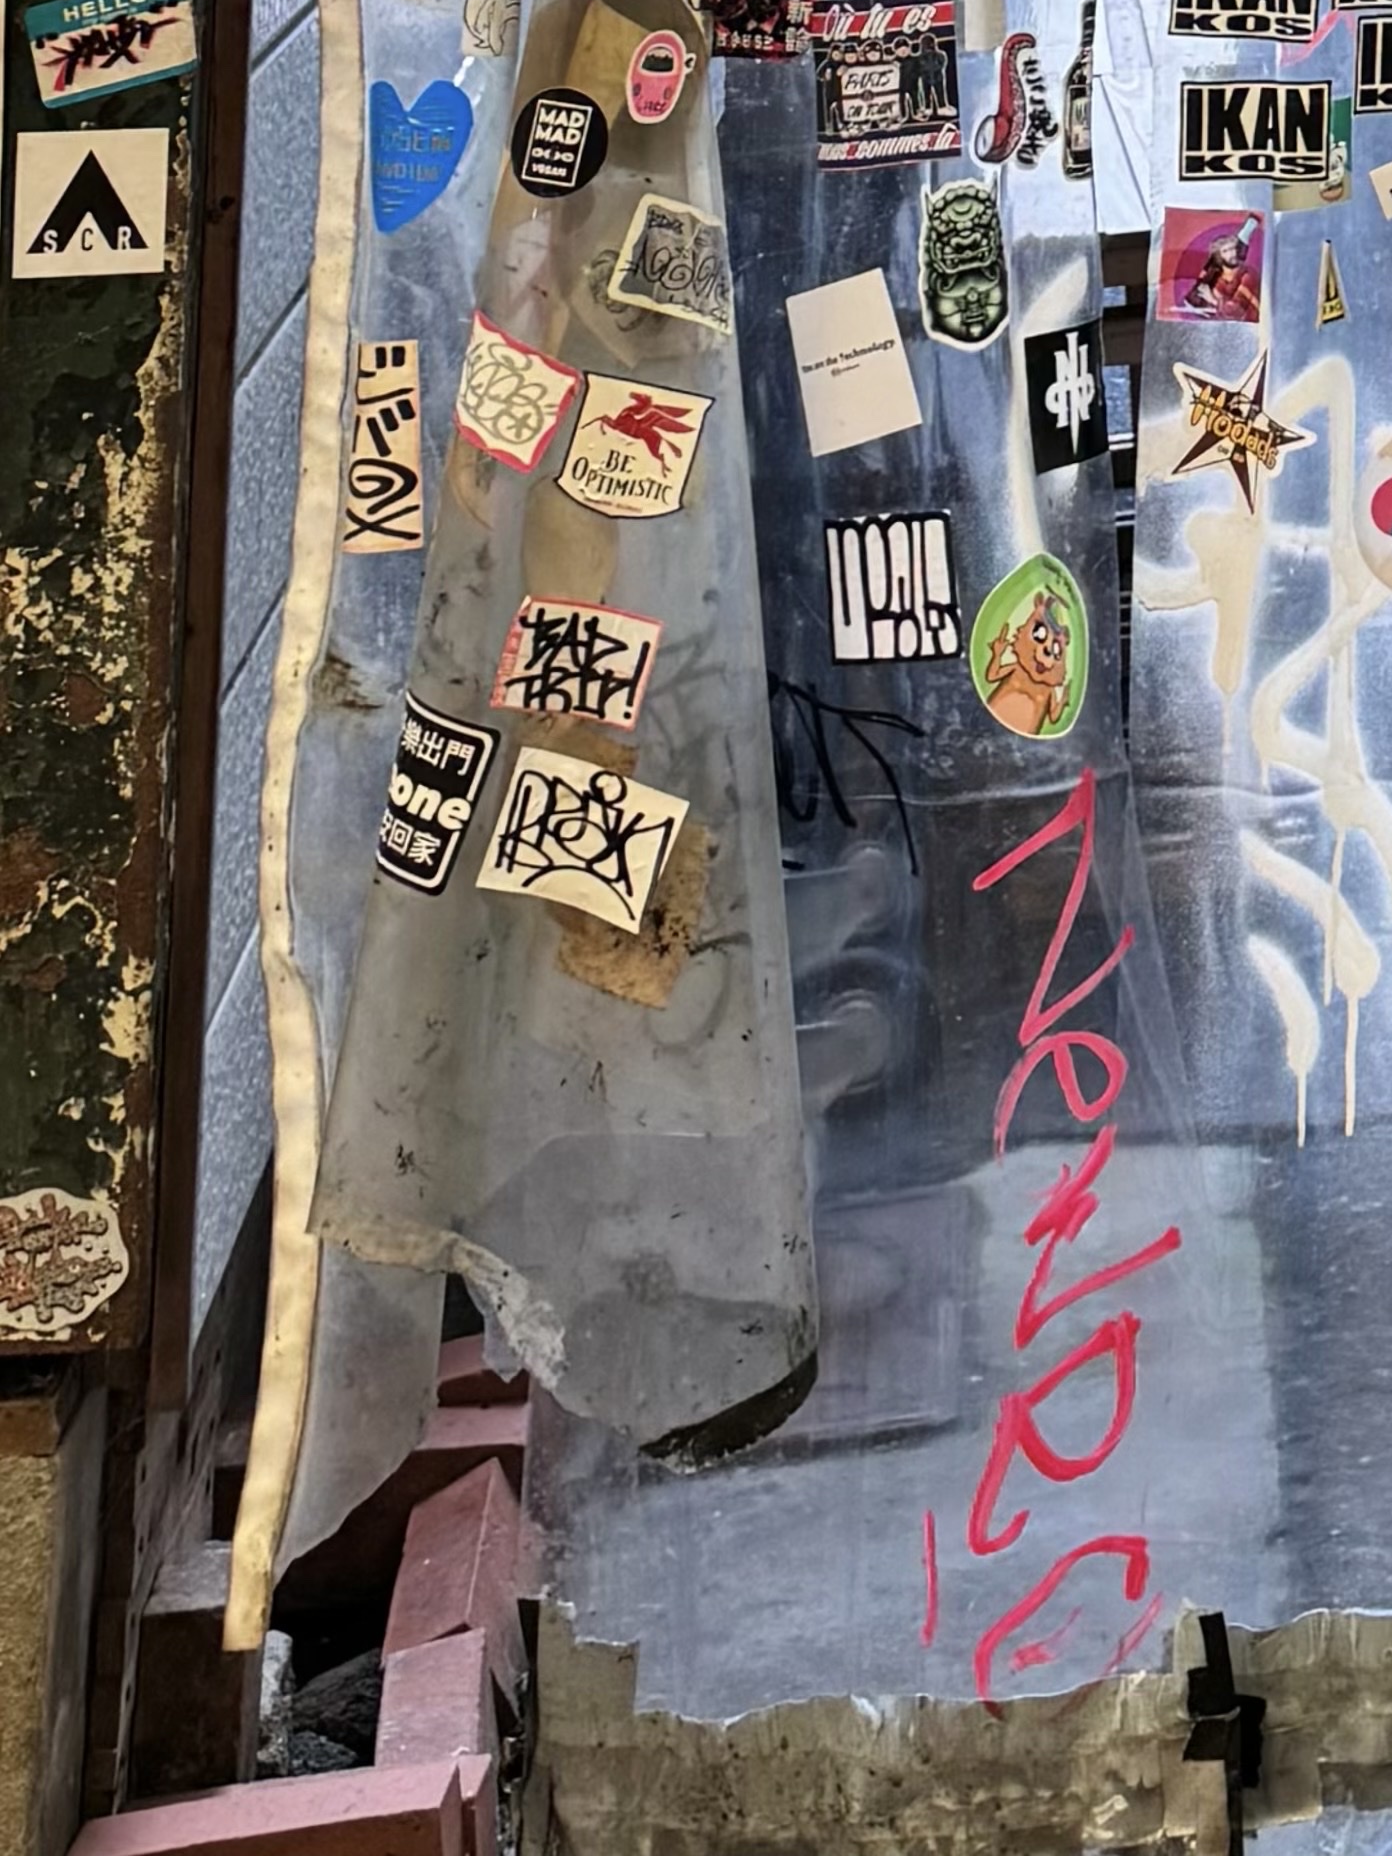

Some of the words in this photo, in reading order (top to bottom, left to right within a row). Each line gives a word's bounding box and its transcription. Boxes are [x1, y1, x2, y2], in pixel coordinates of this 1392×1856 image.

[901, 4, 933, 34] es
[1174, 11, 1314, 37] KOS
[538, 107, 586, 130] MAD
[1184, 86, 1326, 154] IKAN
[534, 124, 583, 147] MAD
[1184, 152, 1326, 175] KOS
[604, 449, 636, 476] BE
[570, 455, 674, 505] OPTIMISTIC
